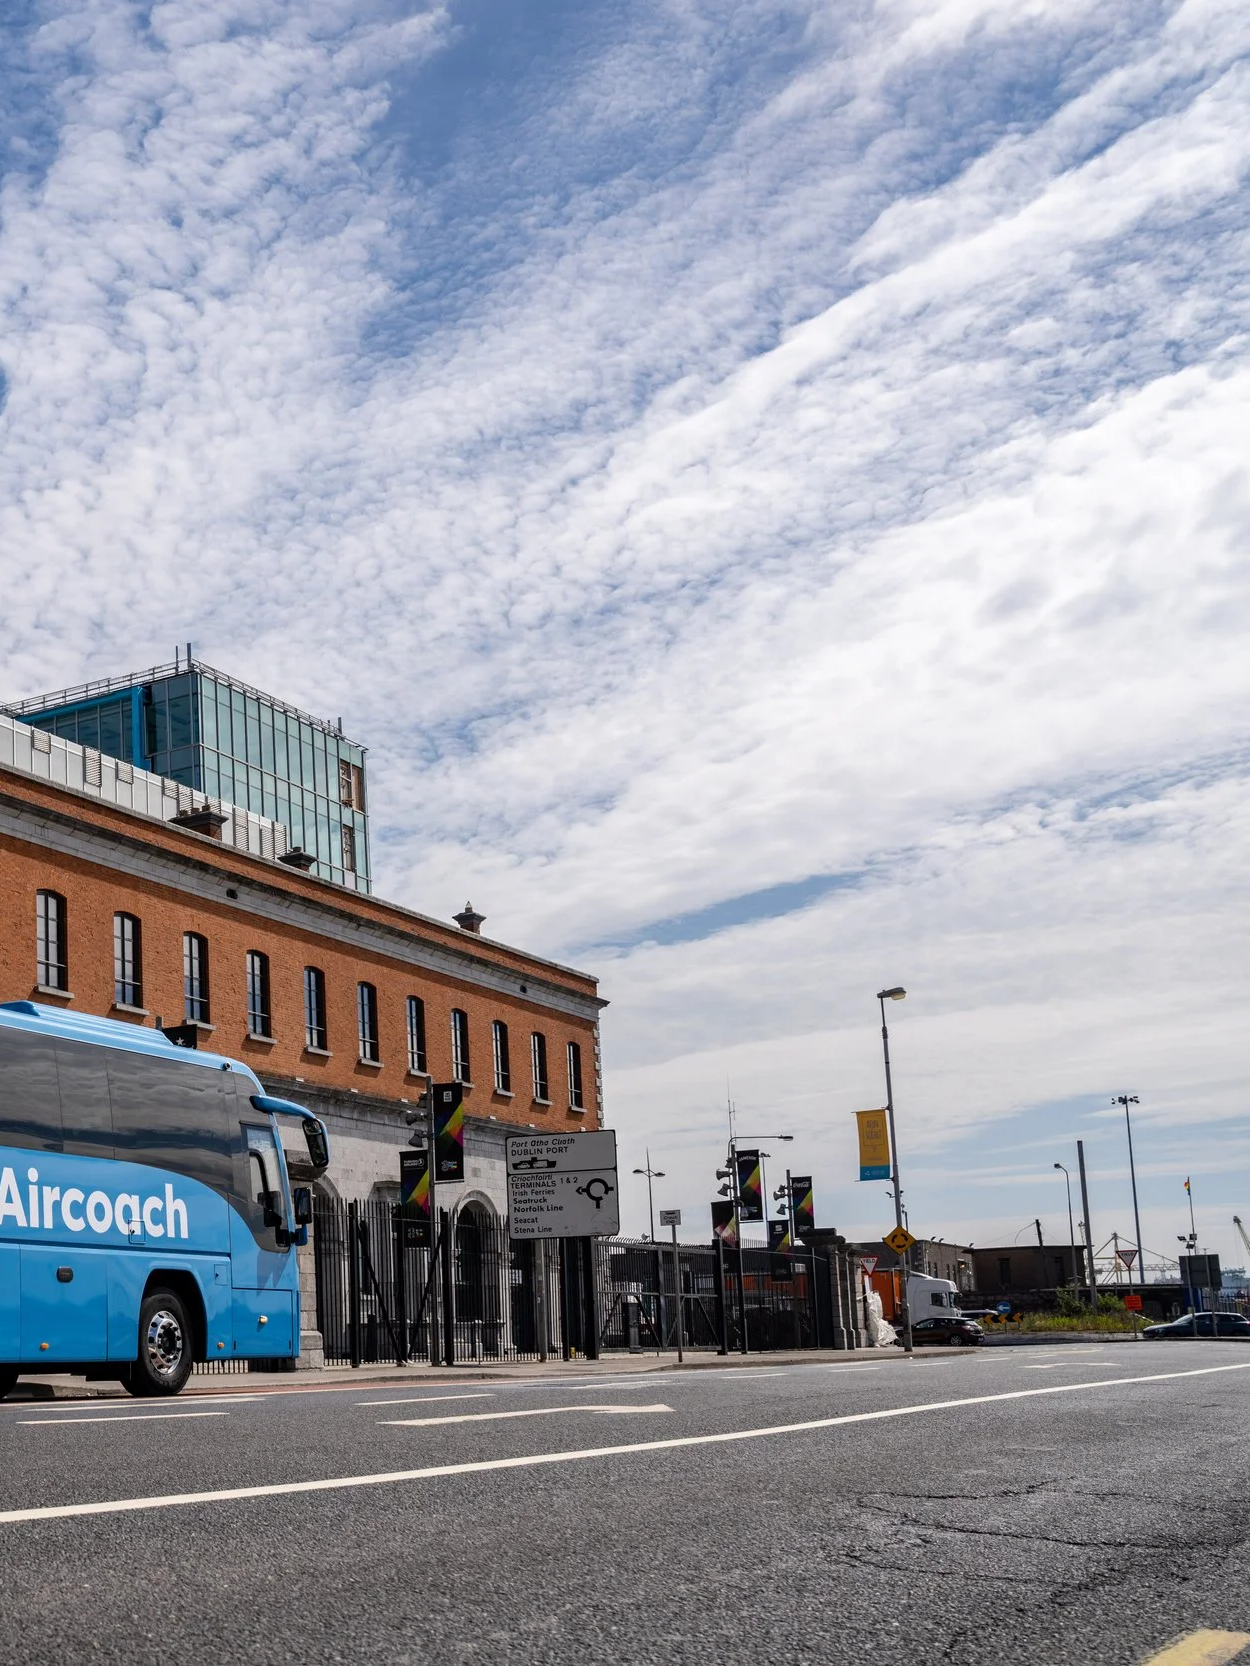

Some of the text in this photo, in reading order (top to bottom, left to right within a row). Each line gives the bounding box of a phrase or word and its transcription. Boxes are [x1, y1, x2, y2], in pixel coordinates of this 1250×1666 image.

[511, 1146, 569, 1156] DUBLIN PORT
[510, 1180, 557, 1189] TERMINALS
[572, 1176, 578, 1184] 2
[530, 1188, 555, 1196] Ferries
[513, 1196, 548, 1205] Seatruck
[513, 1204, 564, 1213] Norfolk Line
[514, 1225, 553, 1234] Stena Line
